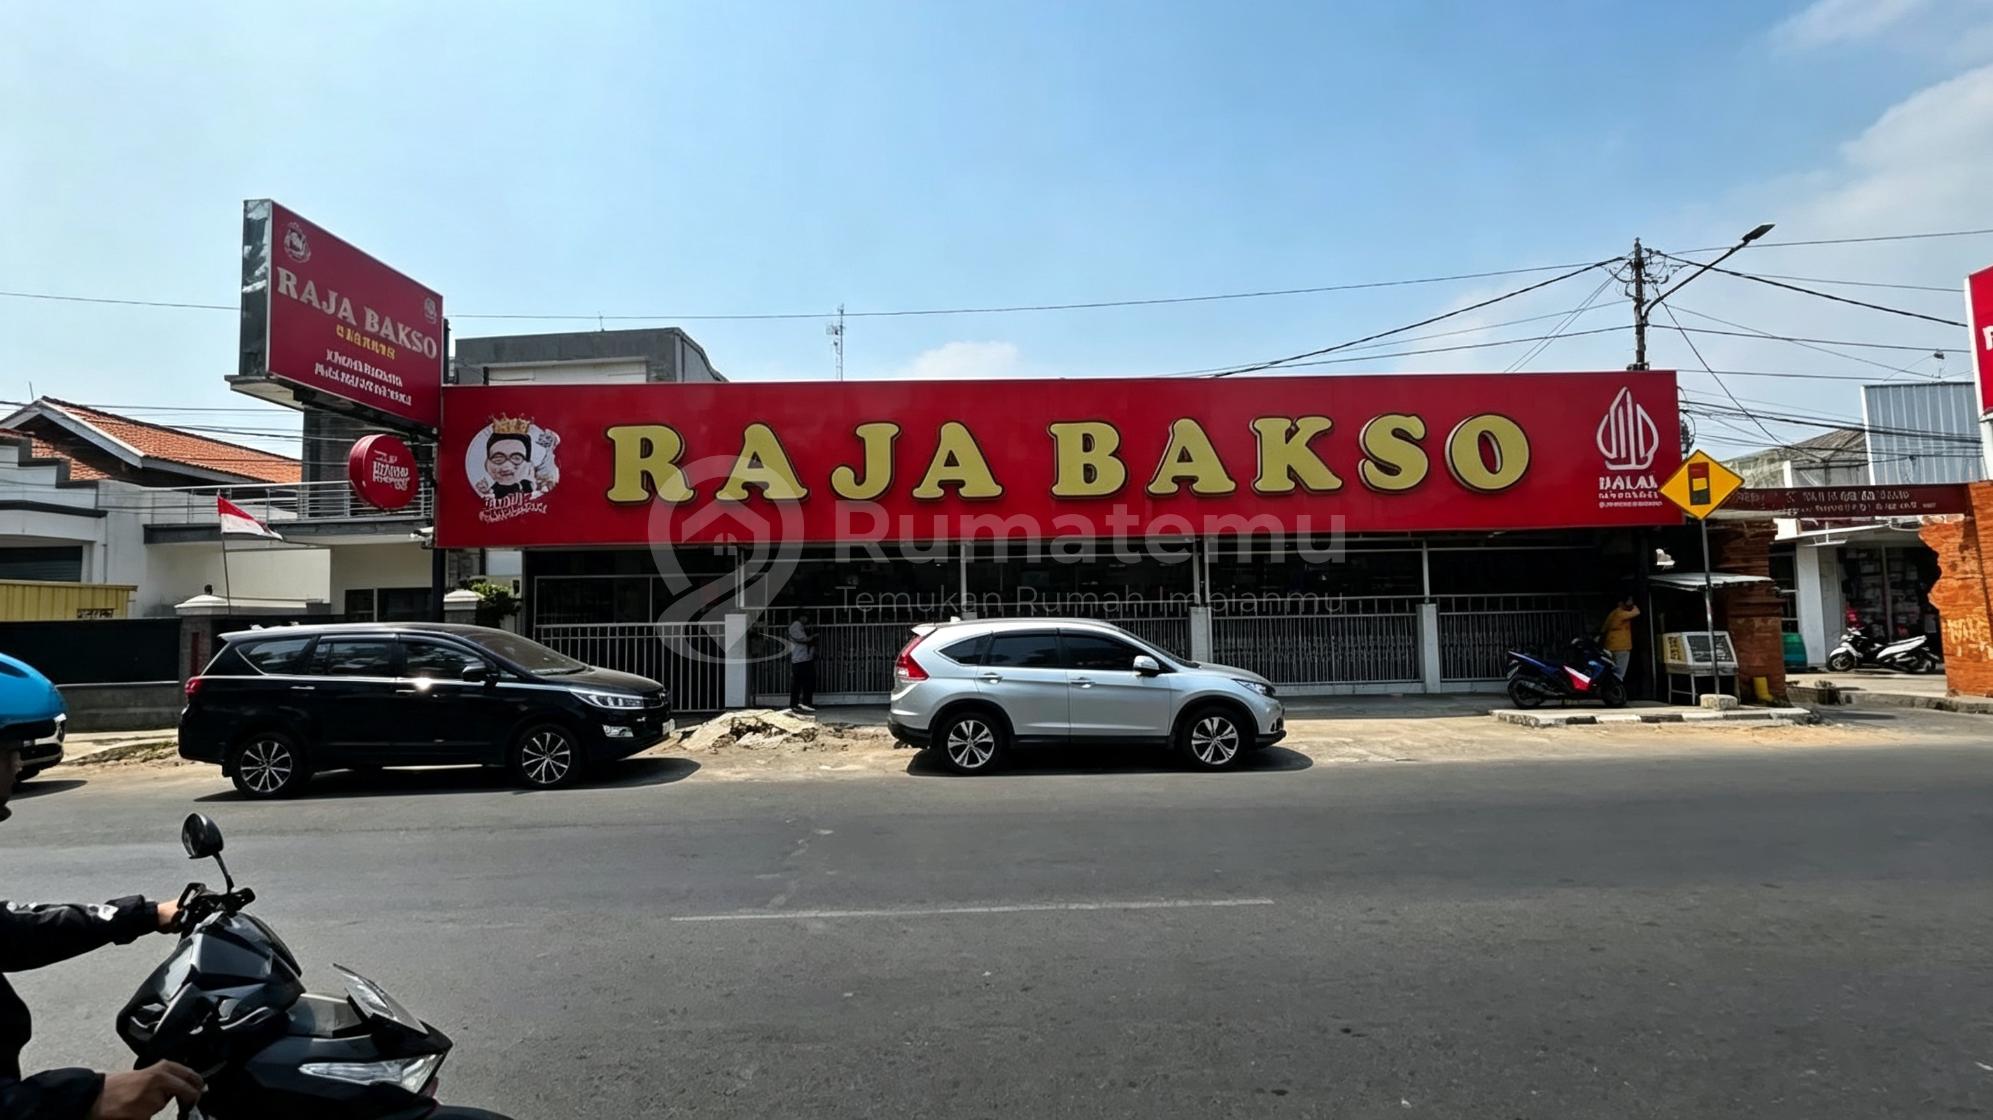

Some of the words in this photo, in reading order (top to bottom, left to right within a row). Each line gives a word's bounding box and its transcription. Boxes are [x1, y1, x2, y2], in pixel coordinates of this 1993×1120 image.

[277, 266, 357, 326] RAJA
[364, 306, 437, 359] BAKSO
[605, 420, 1004, 504] RAJA
[1048, 412, 1532, 498] BAKSO
